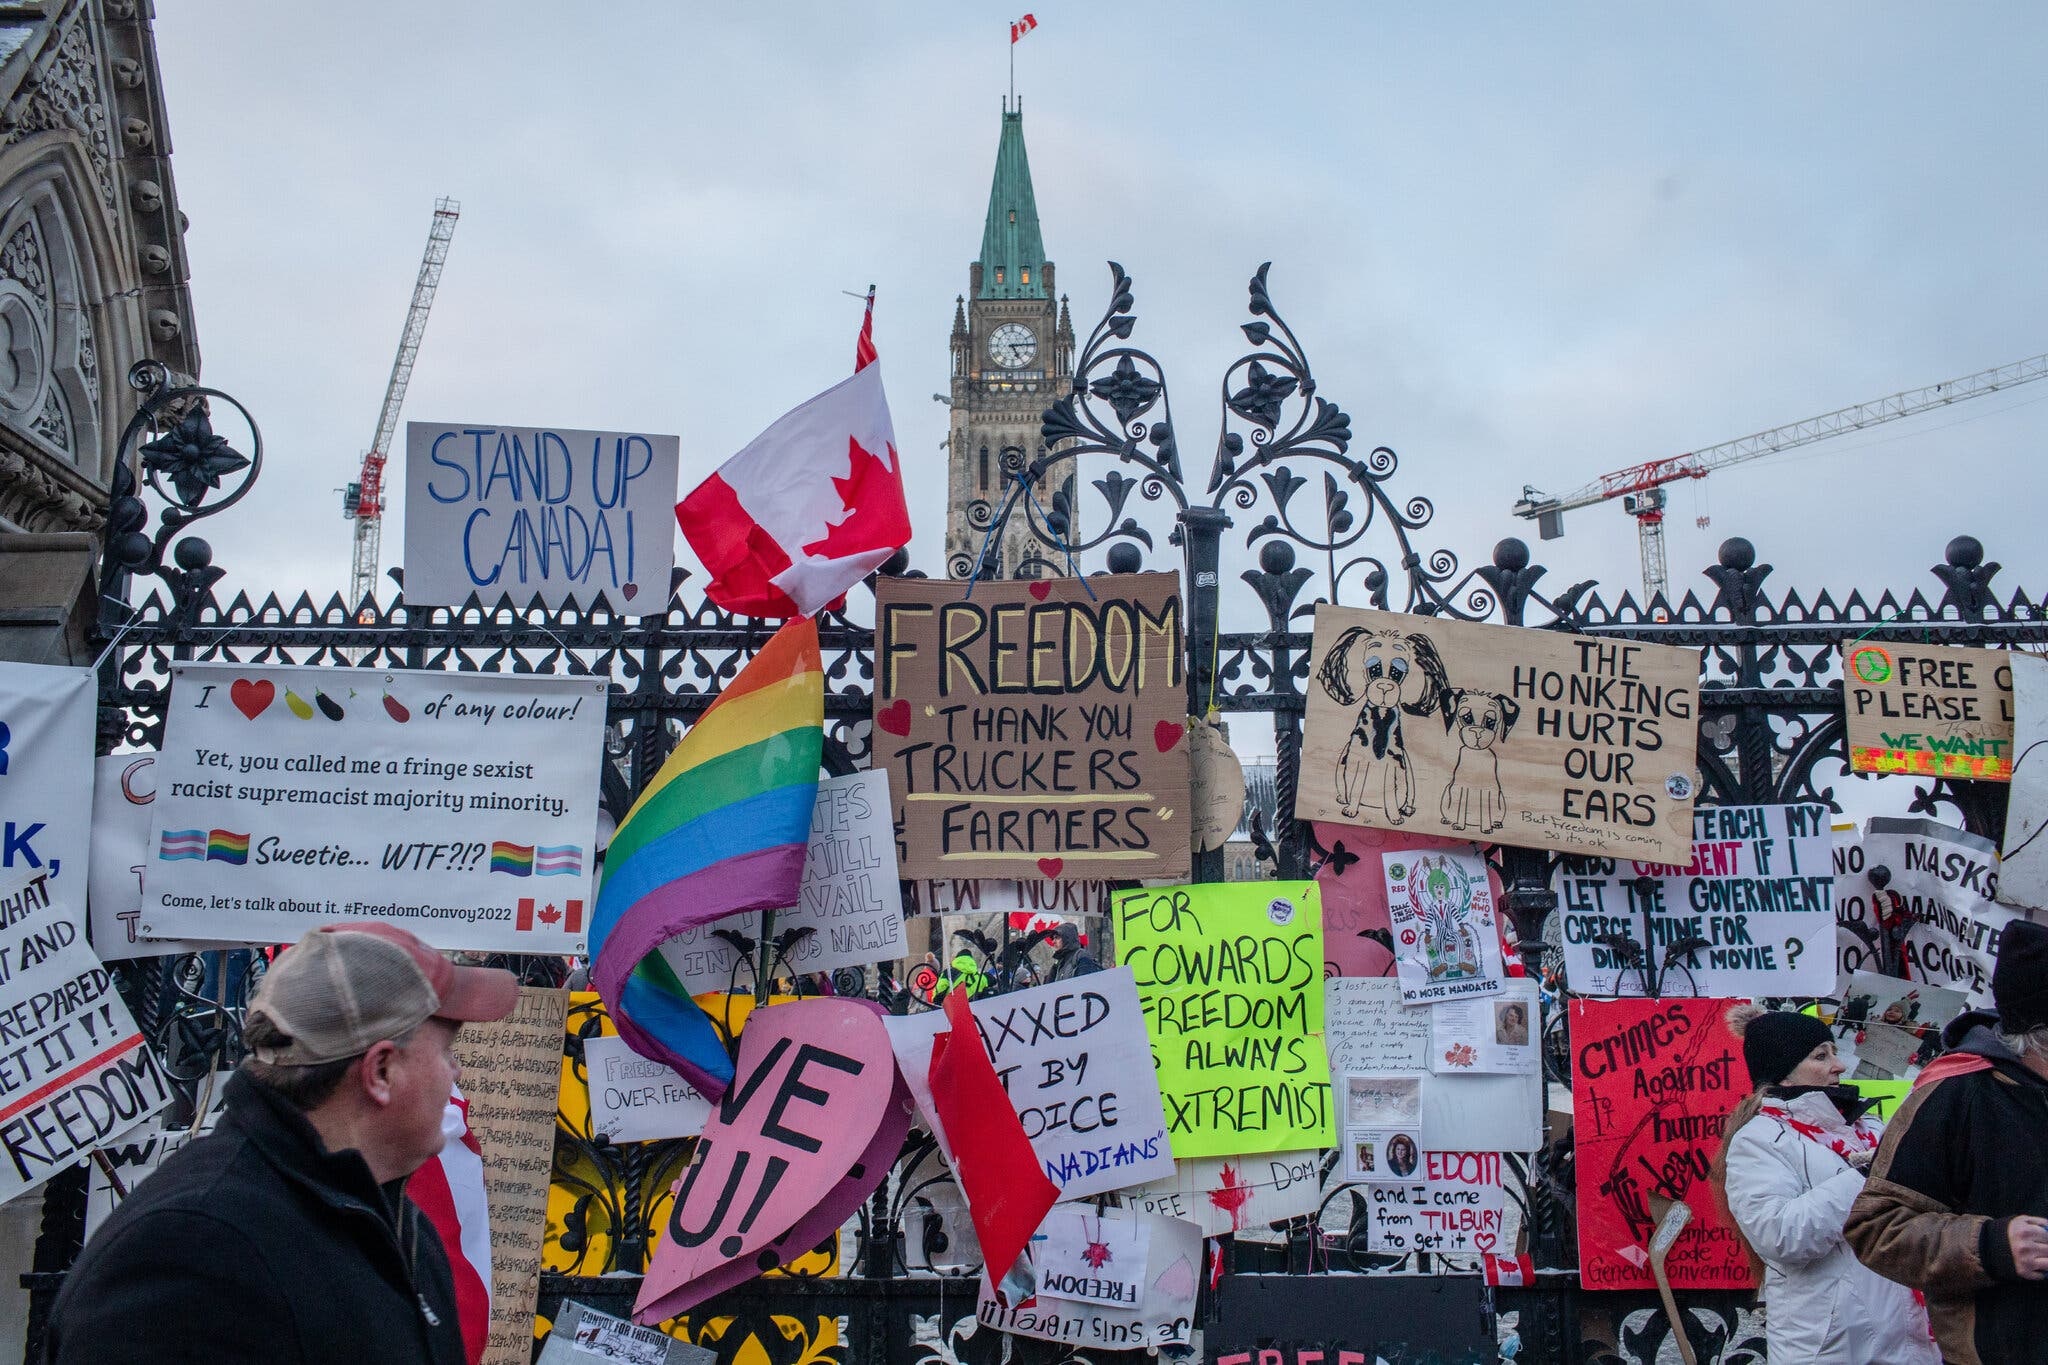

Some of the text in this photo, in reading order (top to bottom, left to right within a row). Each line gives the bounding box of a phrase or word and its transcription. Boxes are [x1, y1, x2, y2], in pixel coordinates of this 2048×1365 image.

[427, 430, 653, 509] STAND UP
[463, 505, 634, 588] CANADA!
[882, 595, 1184, 699] FREEDOM
[1573, 639, 1642, 680] THE
[1898, 657, 1977, 689] FREE
[194, 686, 583, 726] I of any colour!
[1513, 665, 1690, 720] HONKING
[1853, 689, 1981, 722] PLEASE
[1079, 703, 1133, 742] YOU
[1537, 707, 1663, 751] HURTS
[1880, 732, 2009, 759] WE WANT
[195, 749, 534, 781] Yet, you called me a fringe sexist
[894, 742, 1142, 793] TRUCKERS
[1564, 748, 1635, 785] OUR
[171, 780, 234, 799] racist
[237, 784, 369, 807] supremacist
[373, 787, 464, 814] majority
[469, 790, 570, 817] minority.
[1562, 788, 1657, 827] EARS
[1521, 811, 1549, 825] But
[1625, 834, 1663, 852] coming
[1785, 806, 1824, 837] MY
[255, 835, 487, 873] Sweetie... WTF?!?
[1753, 839, 1774, 876] IF
[1789, 839, 1799, 876] I
[1905, 842, 1999, 902] MASKS
[160, 893, 512, 922] Come, let's talk about it. #FreedomConvoy2022
[1563, 876, 1834, 913] LET TE GOVERNMENT
[1121, 891, 1204, 940] FOR
[1564, 915, 1633, 945] COERCE
[1650, 916, 1703, 946] MINE
[1709, 916, 1753, 946] FOR
[20, 921, 75, 971] AND
[685, 948, 734, 977] IN
[831, 913, 899, 954] NAME
[1124, 933, 1314, 992] COWARDS
[1592, 946, 1658, 970] DINE
[1710, 946, 1777, 970] MOVIE
[1403, 980, 1498, 1000] NO MORE MANDATES
[1038, 1052, 1088, 1089] BY
[1186, 1037, 1307, 1074] ALWAYS
[1633, 1049, 1737, 1105] Against
[604, 1084, 702, 1110] OVER FEAR
[1270, 1160, 1316, 1191] DOM
[1374, 1186, 1480, 1205] and I came
[1376, 1207, 1503, 1233] from TILBURY
[1384, 1231, 1467, 1253] to get it
[1044, 1270, 1137, 1303] FREEDOM
[580, 1310, 670, 1348] CONVOY FOR FREEDOM
